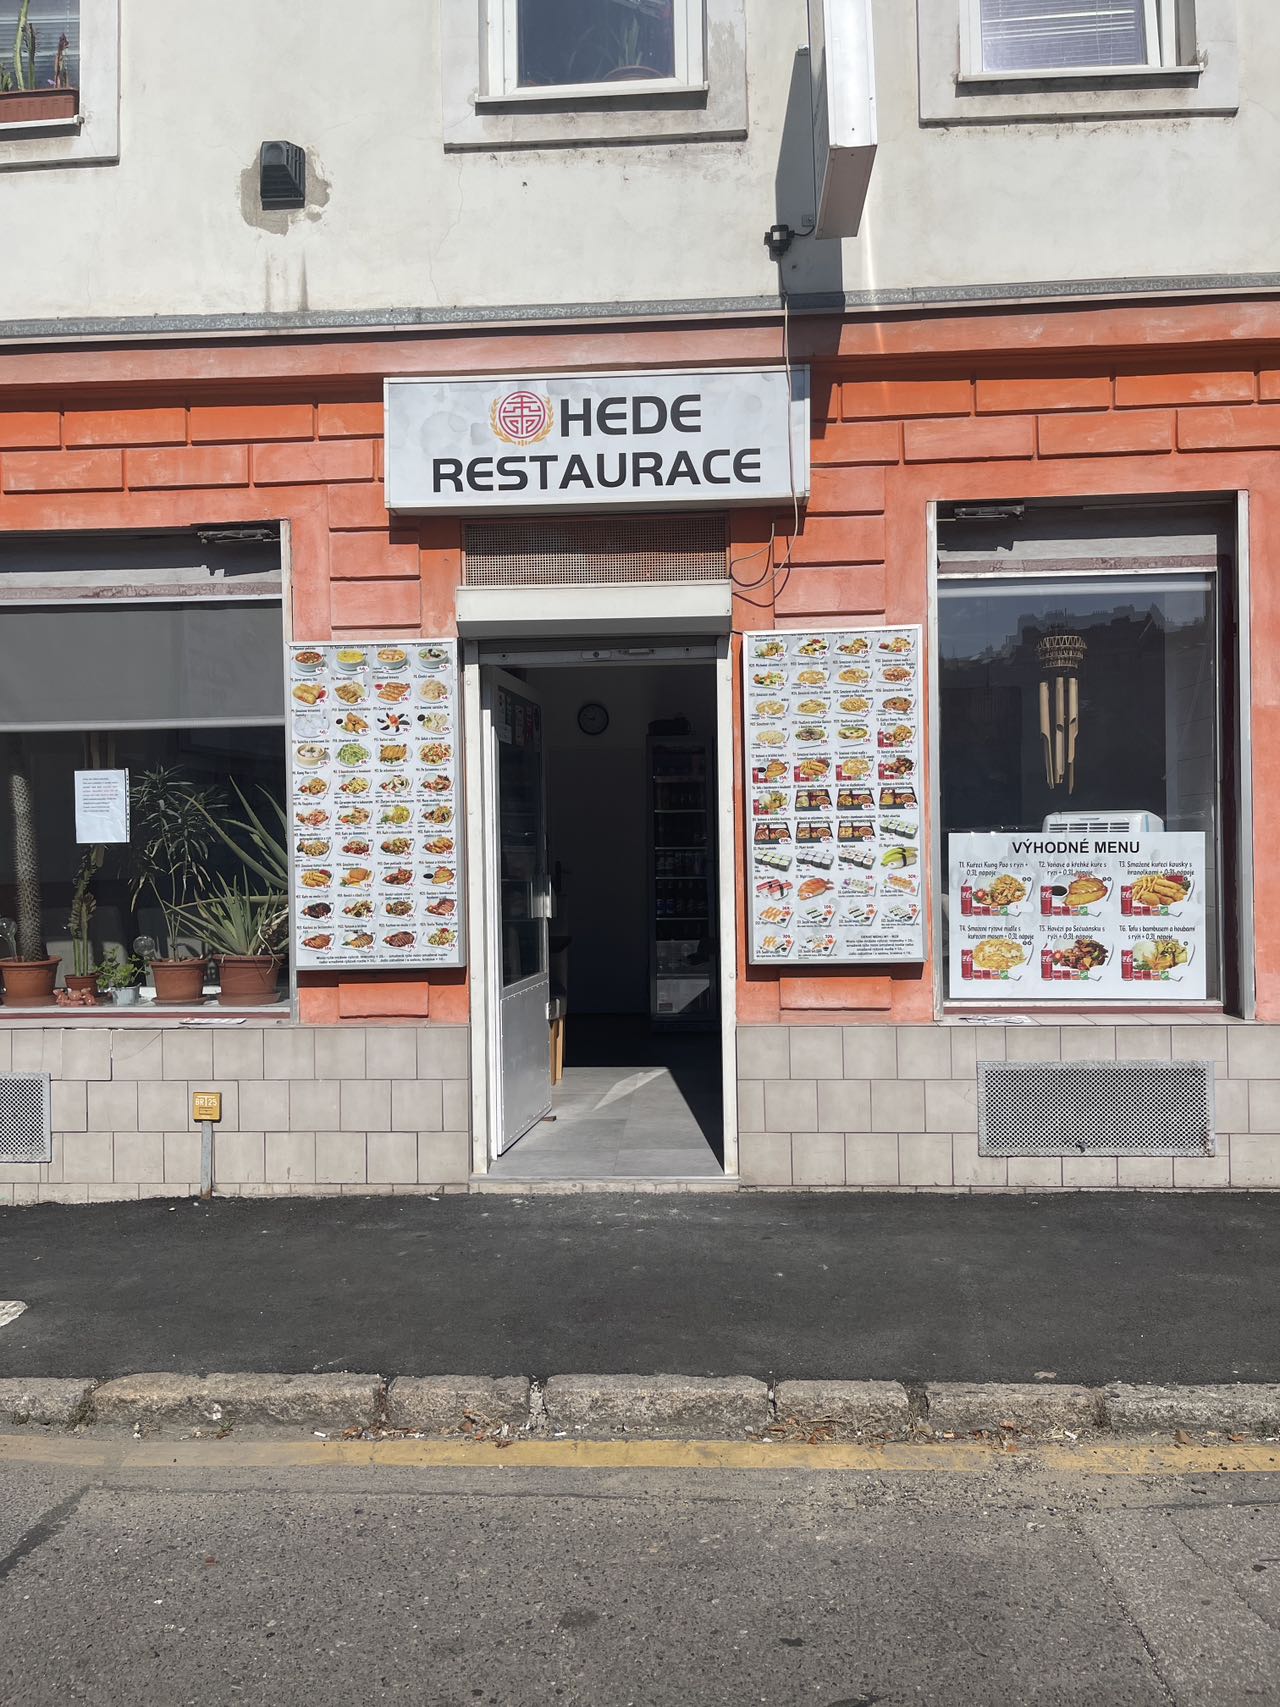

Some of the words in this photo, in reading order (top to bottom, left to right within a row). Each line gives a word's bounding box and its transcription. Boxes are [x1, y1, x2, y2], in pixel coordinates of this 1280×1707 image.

[560, 394, 702, 437] HEDE
[432, 448, 762, 493] RESTAURACE
[1012, 839, 1089, 854] VÝHODNÉ
[1094, 840, 1140, 854] MENU
